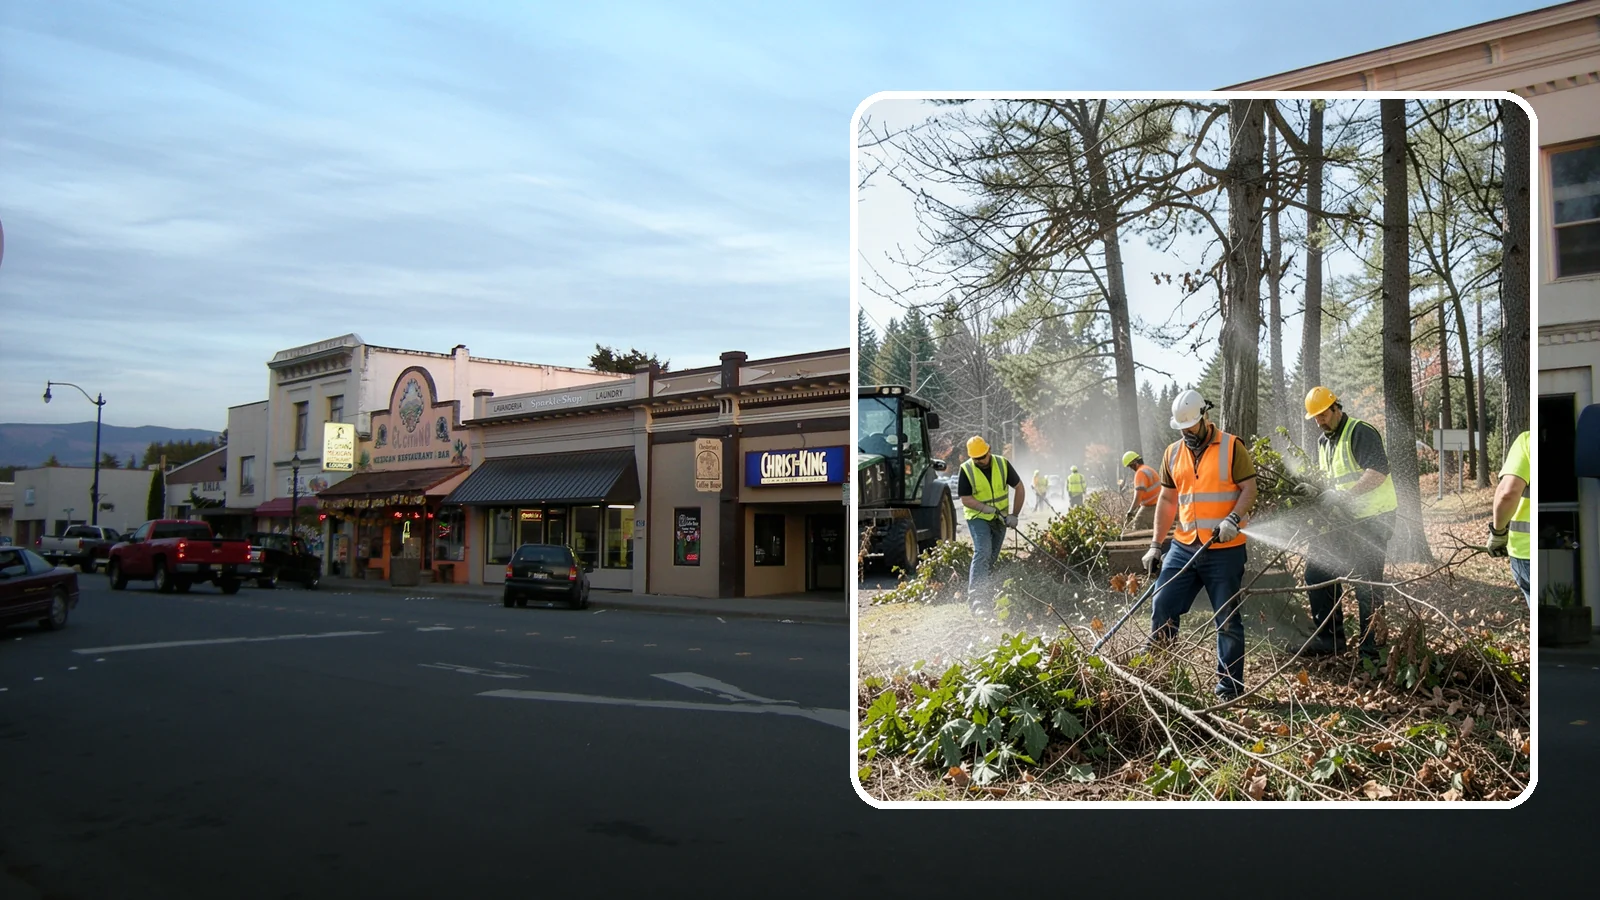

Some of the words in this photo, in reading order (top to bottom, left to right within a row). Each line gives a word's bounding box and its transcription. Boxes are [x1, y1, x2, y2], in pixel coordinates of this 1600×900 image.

[493, 402, 523, 413] LAVANDERIA
[561, 394, 582, 404] Shop
[595, 388, 624, 400] LAUNDRY
[373, 455, 396, 464] MEXICAN
[397, 451, 433, 463] RESTAURANT
[437, 450, 450, 459] BAR
[760, 452, 798, 478] CHRIST
[799, 450, 827, 476] KING
[696, 480, 709, 488] Coffee
